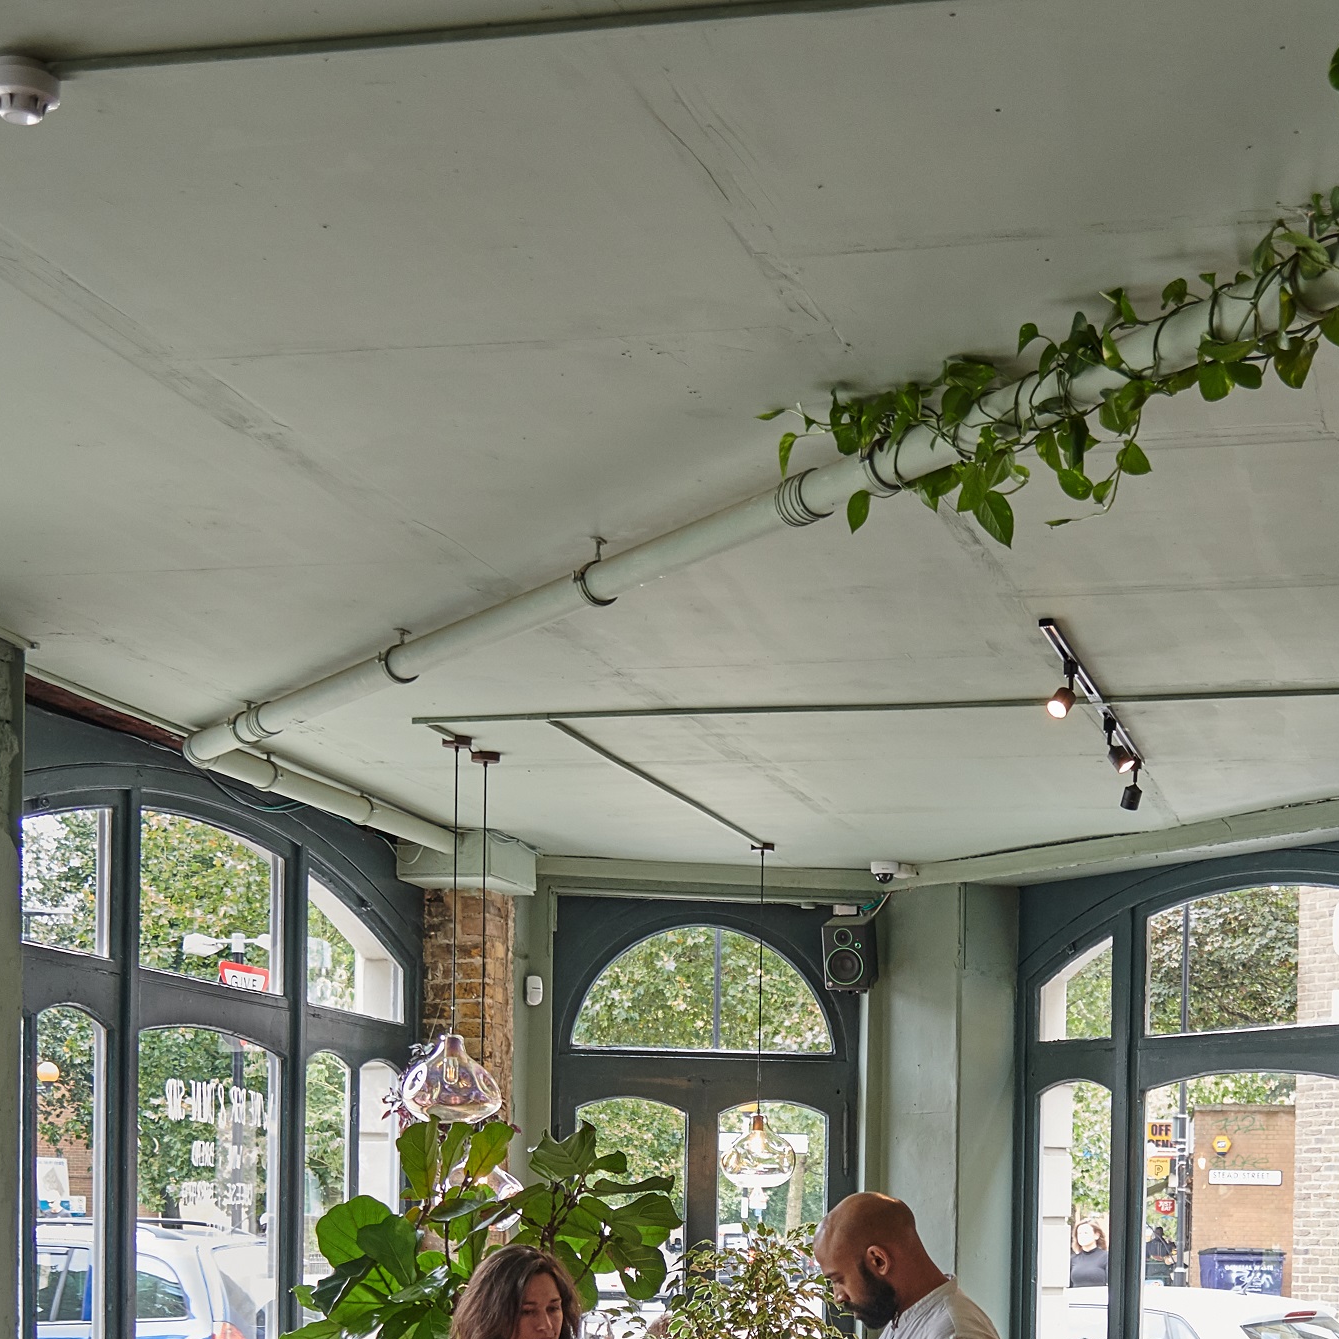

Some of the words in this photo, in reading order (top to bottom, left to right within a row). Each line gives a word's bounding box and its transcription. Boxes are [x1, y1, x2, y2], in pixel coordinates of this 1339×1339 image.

[1151, 1124, 1172, 1136] OFF
[1213, 1171, 1238, 1179] STEAD
[1243, 1172, 1270, 1180] STREET
